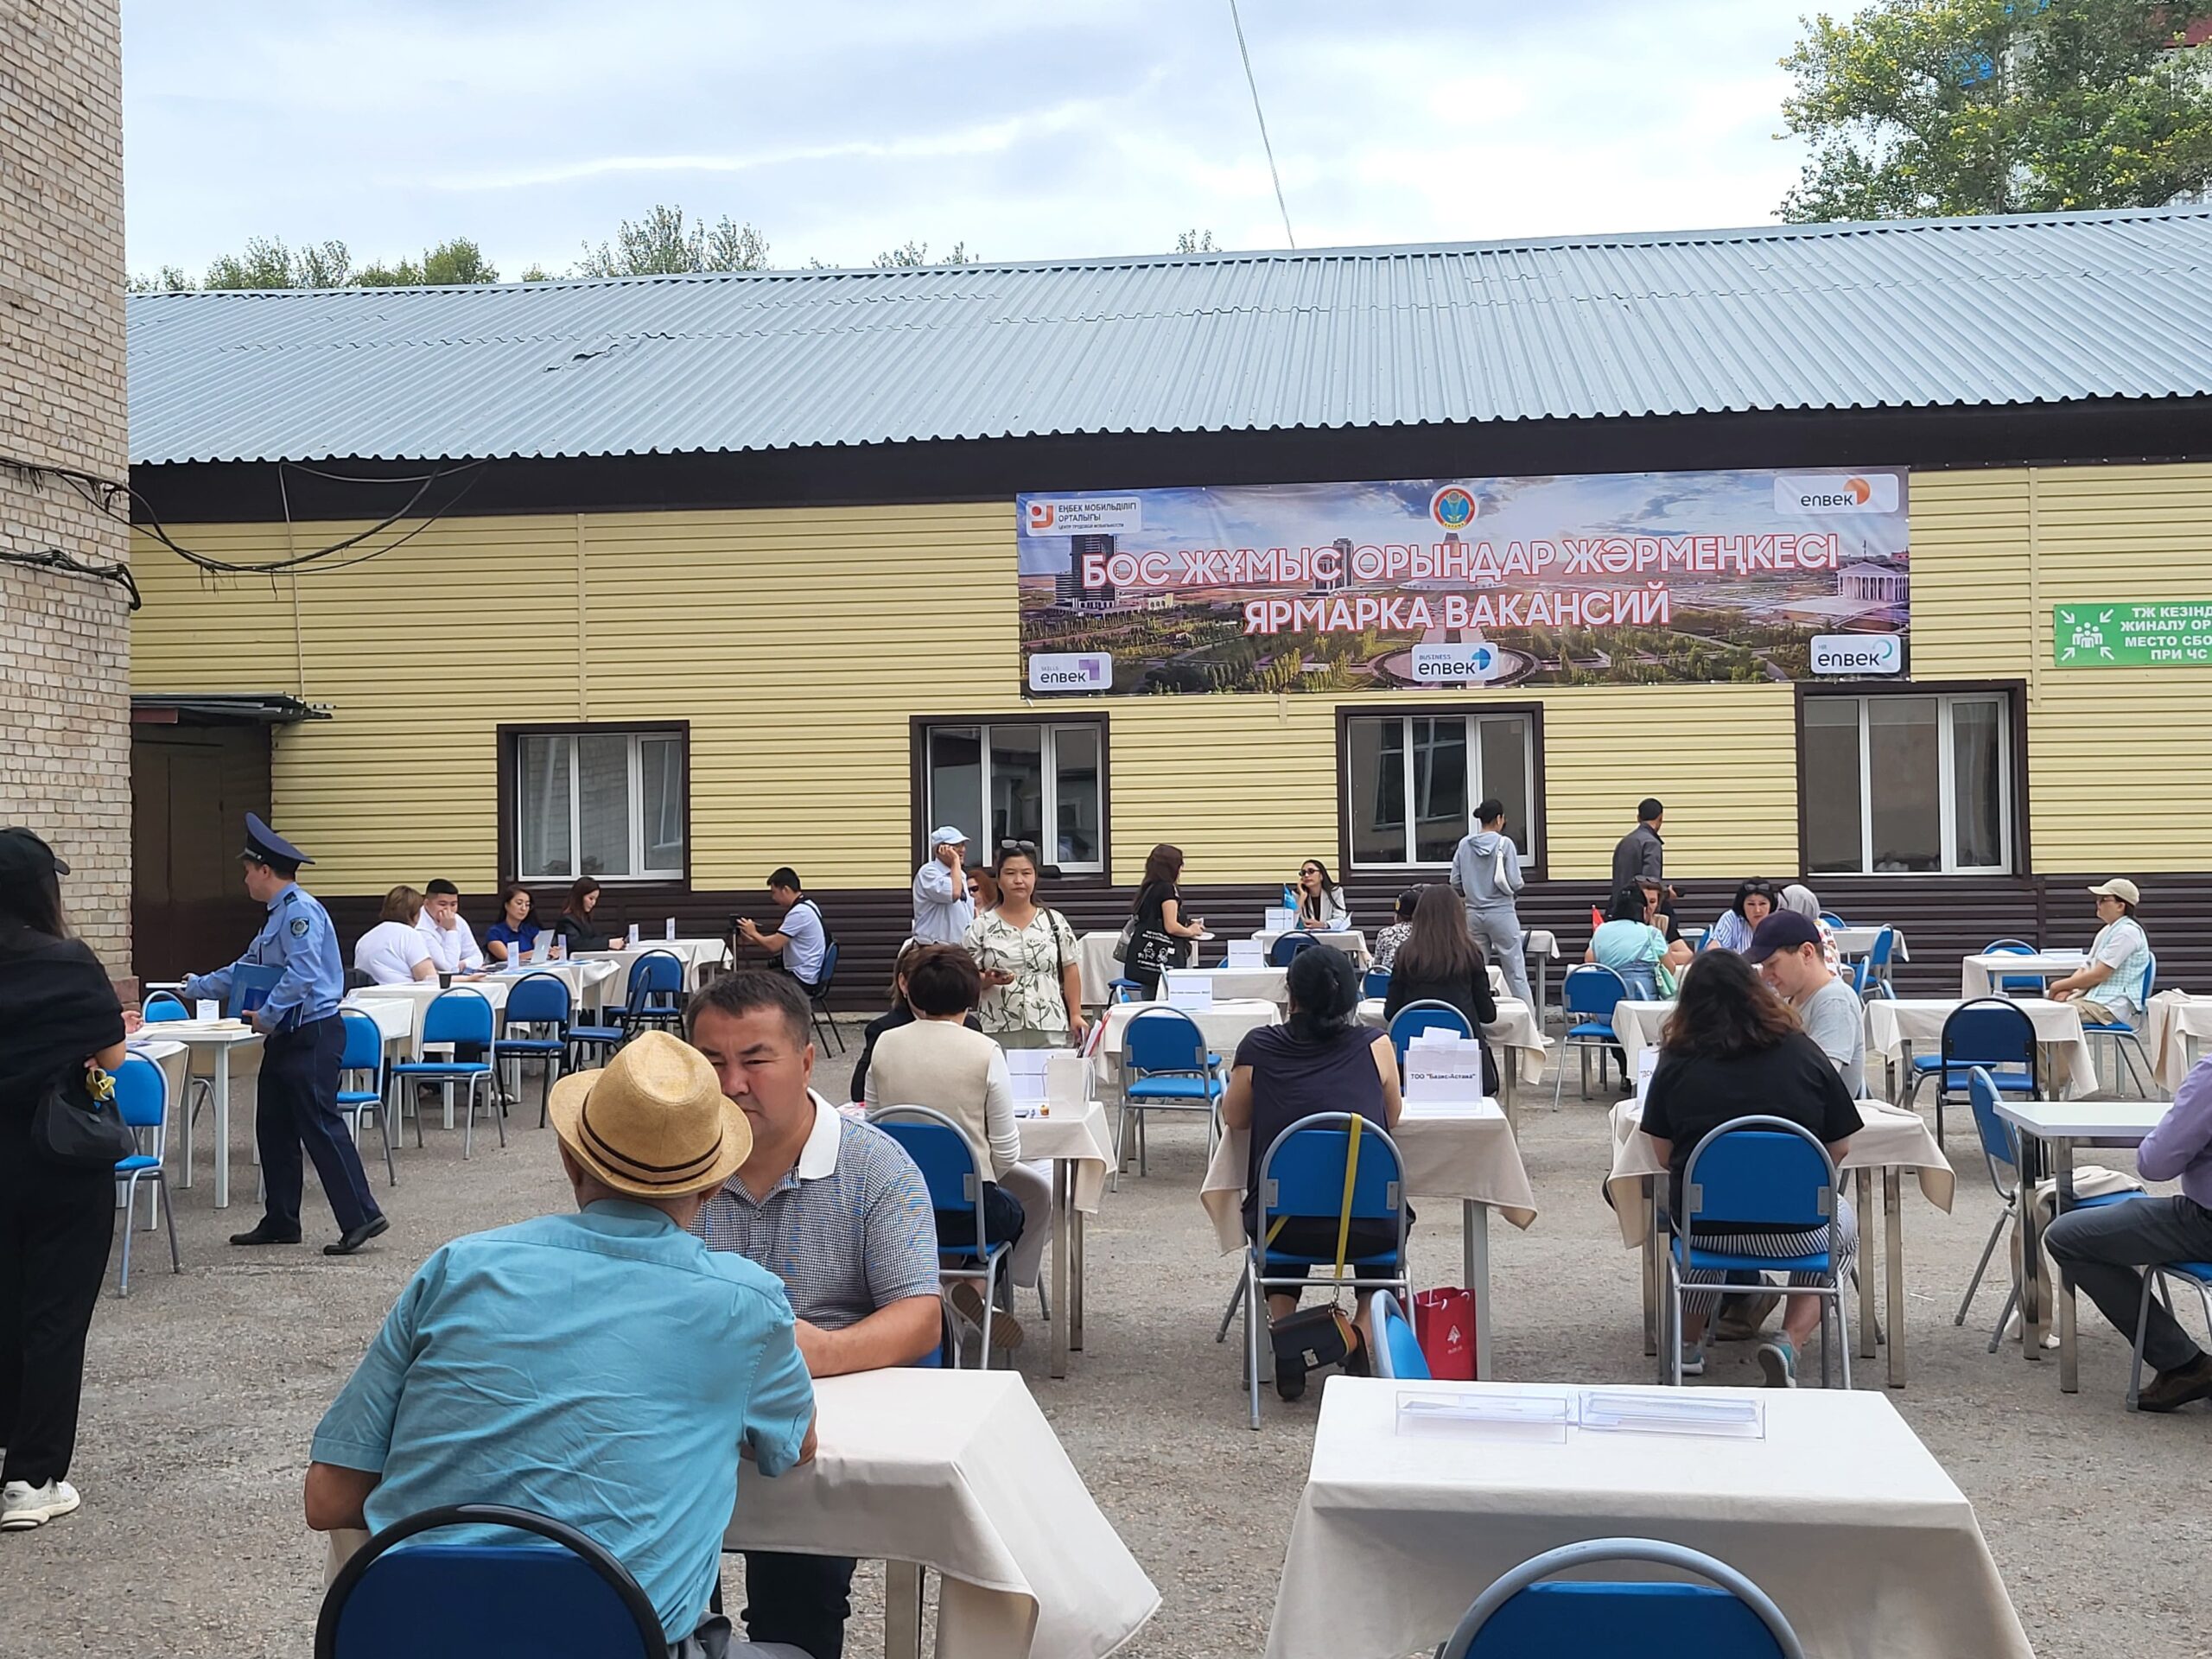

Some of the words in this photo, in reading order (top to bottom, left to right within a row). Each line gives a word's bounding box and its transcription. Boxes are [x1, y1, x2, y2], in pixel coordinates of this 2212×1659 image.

[1058, 504, 1083, 513] ЕҢБЕК
[1082, 550, 1171, 588] БОС
[1179, 546, 1341, 586] ЖҰМЫС
[1351, 541, 1556, 582] ОРЫНДАР
[1563, 533, 1837, 575] ЖӘРМЕҢКЕСІ
[1244, 595, 1434, 634] ЯРМАРКА
[1445, 581, 1670, 629] ВАКАНСИЙ
[2132, 607, 2156, 618] ТЖ
[2120, 620, 2186, 632] ЖИНАЛУ
[2125, 636, 2177, 647] МЕСТО
[2182, 635, 2212, 646] СБО
[2152, 649, 2182, 660] ПРИ
[2187, 648, 2208, 659] ЧС
